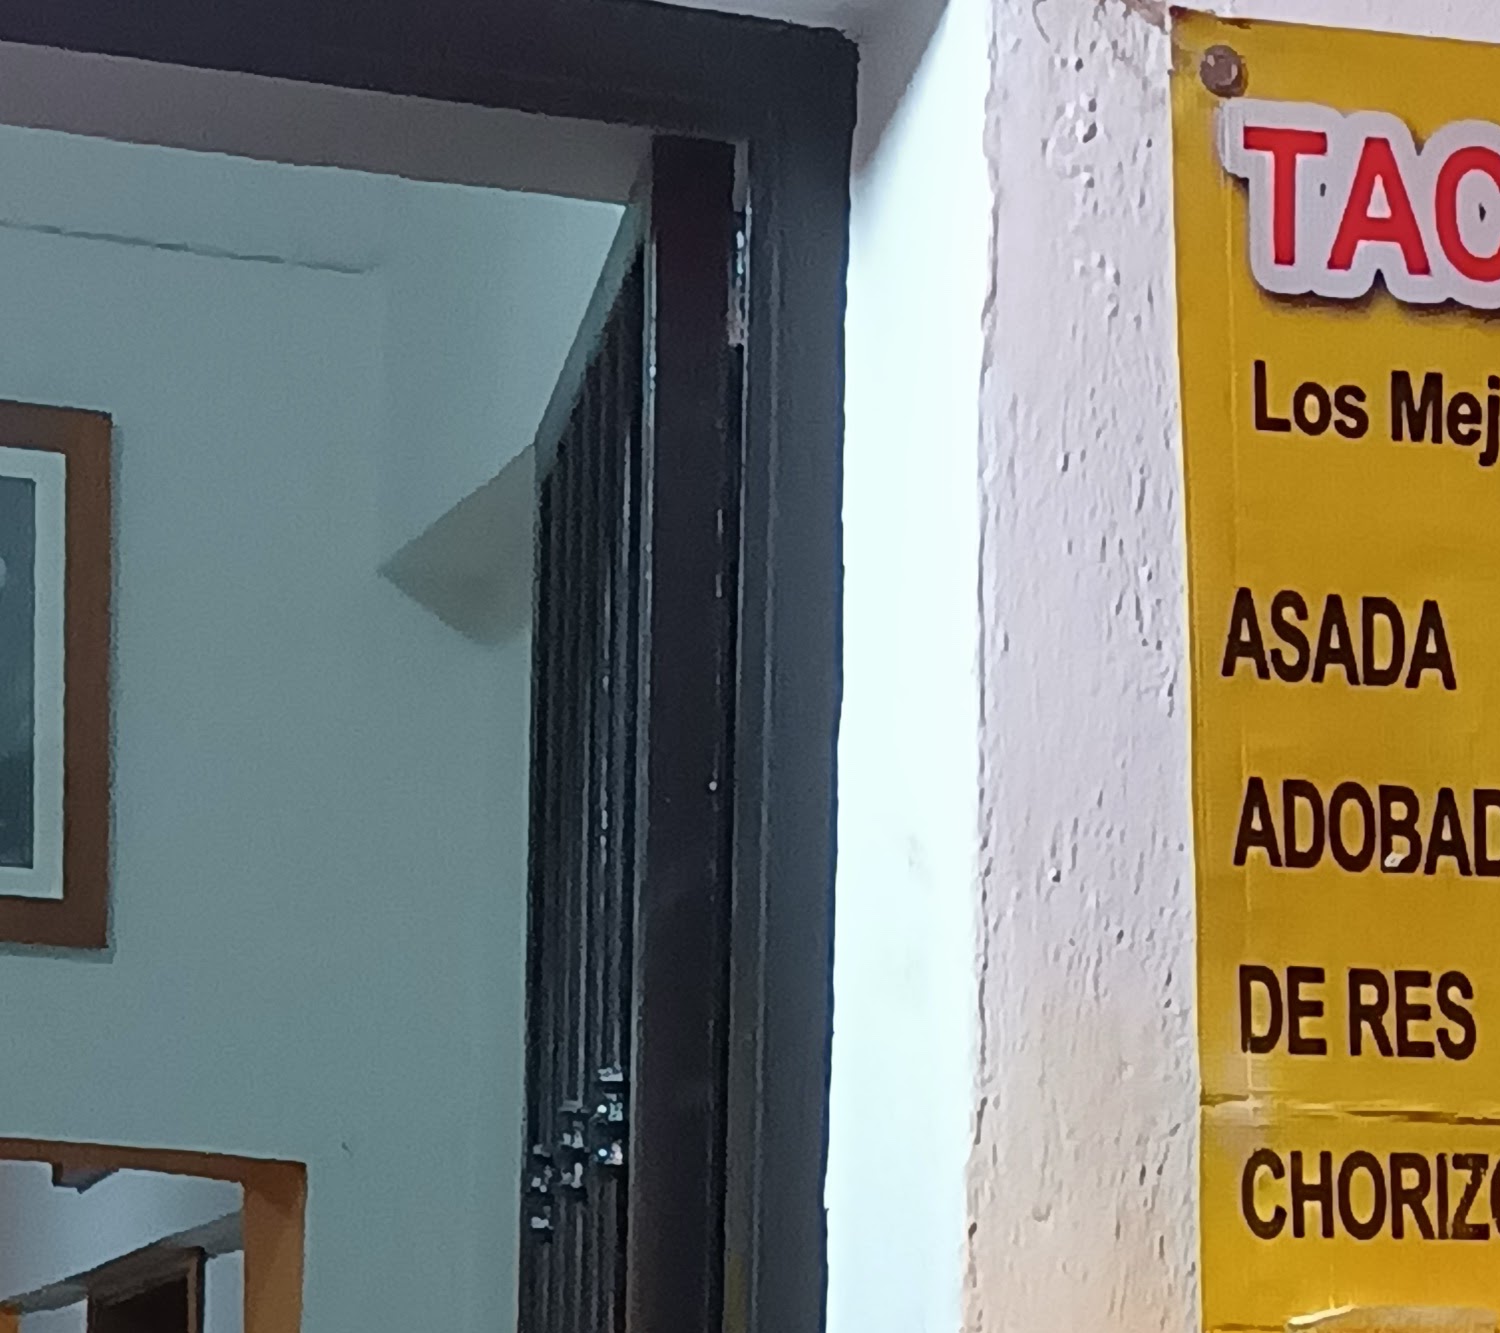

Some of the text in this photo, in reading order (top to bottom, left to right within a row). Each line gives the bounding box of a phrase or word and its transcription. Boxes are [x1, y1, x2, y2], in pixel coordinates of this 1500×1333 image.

[1253, 359, 1370, 439] Los
[1220, 586, 1458, 691] ASADA
[1238, 963, 1477, 1061] DE RES
